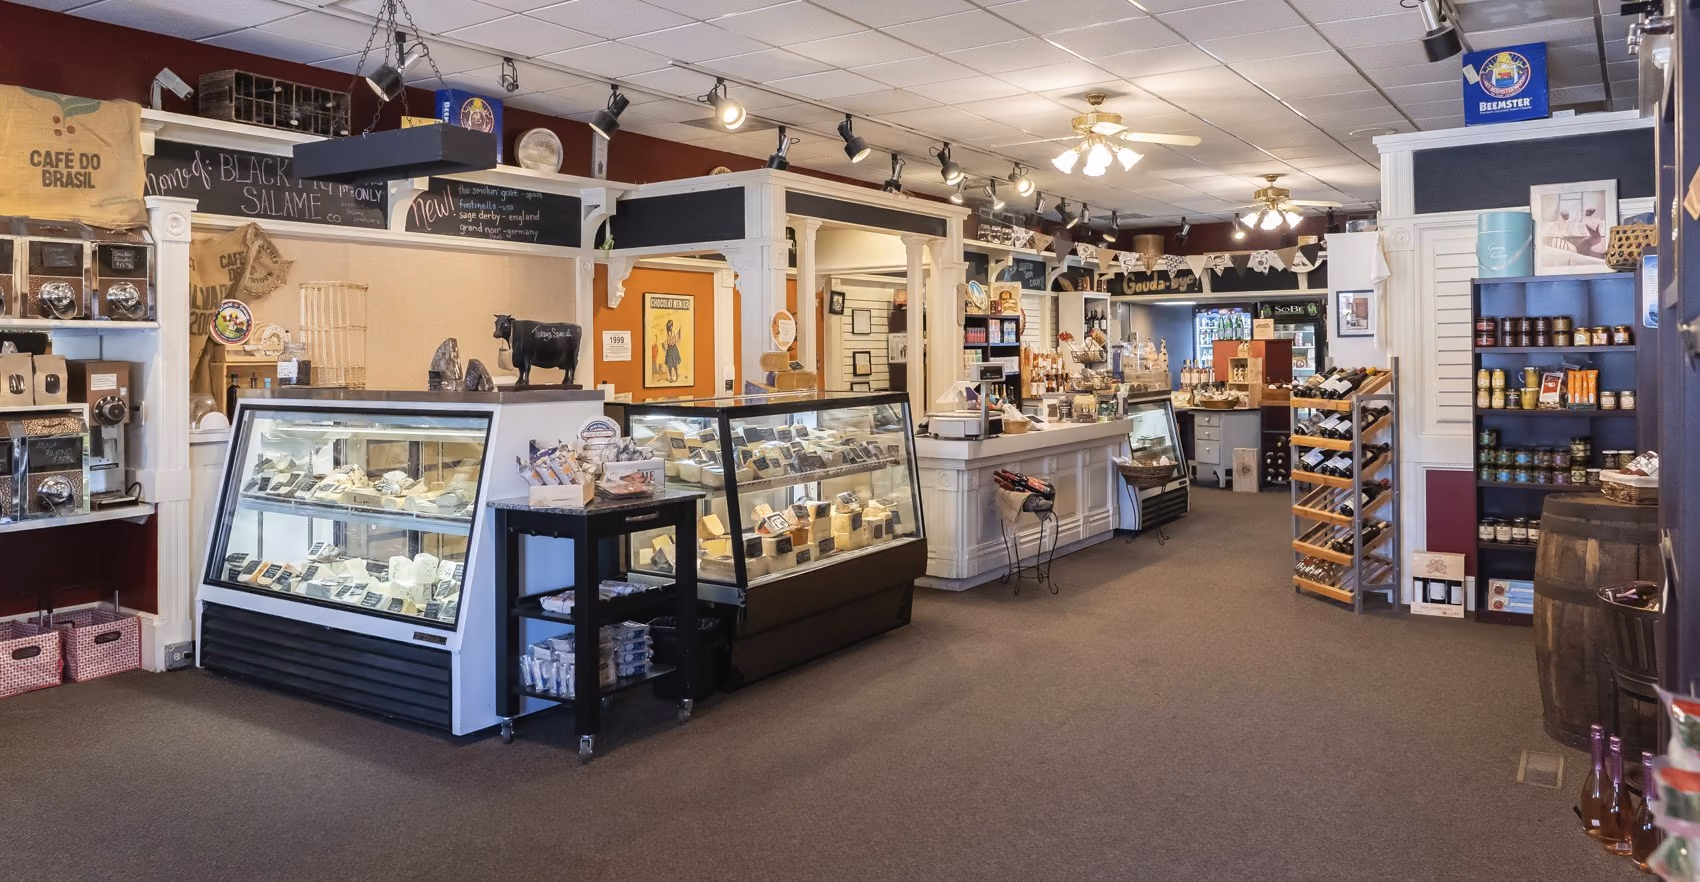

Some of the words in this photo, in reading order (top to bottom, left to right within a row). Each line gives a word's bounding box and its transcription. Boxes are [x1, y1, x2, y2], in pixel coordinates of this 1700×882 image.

[1479, 97, 1530, 112] BEEMSTER
[30, 148, 75, 170] CAFÉ
[79, 152, 101, 171] DO
[219, 153, 291, 187] BLACK
[42, 169, 96, 189] BRASIL
[355, 187, 382, 203] ONLY
[458, 186, 470, 195] the
[500, 188, 518, 201] goat
[240, 186, 322, 220] SALAME
[459, 211, 476, 222] sage
[508, 209, 540, 225] england
[460, 222, 483, 235] grand
[609, 336, 625, 344] 1999
